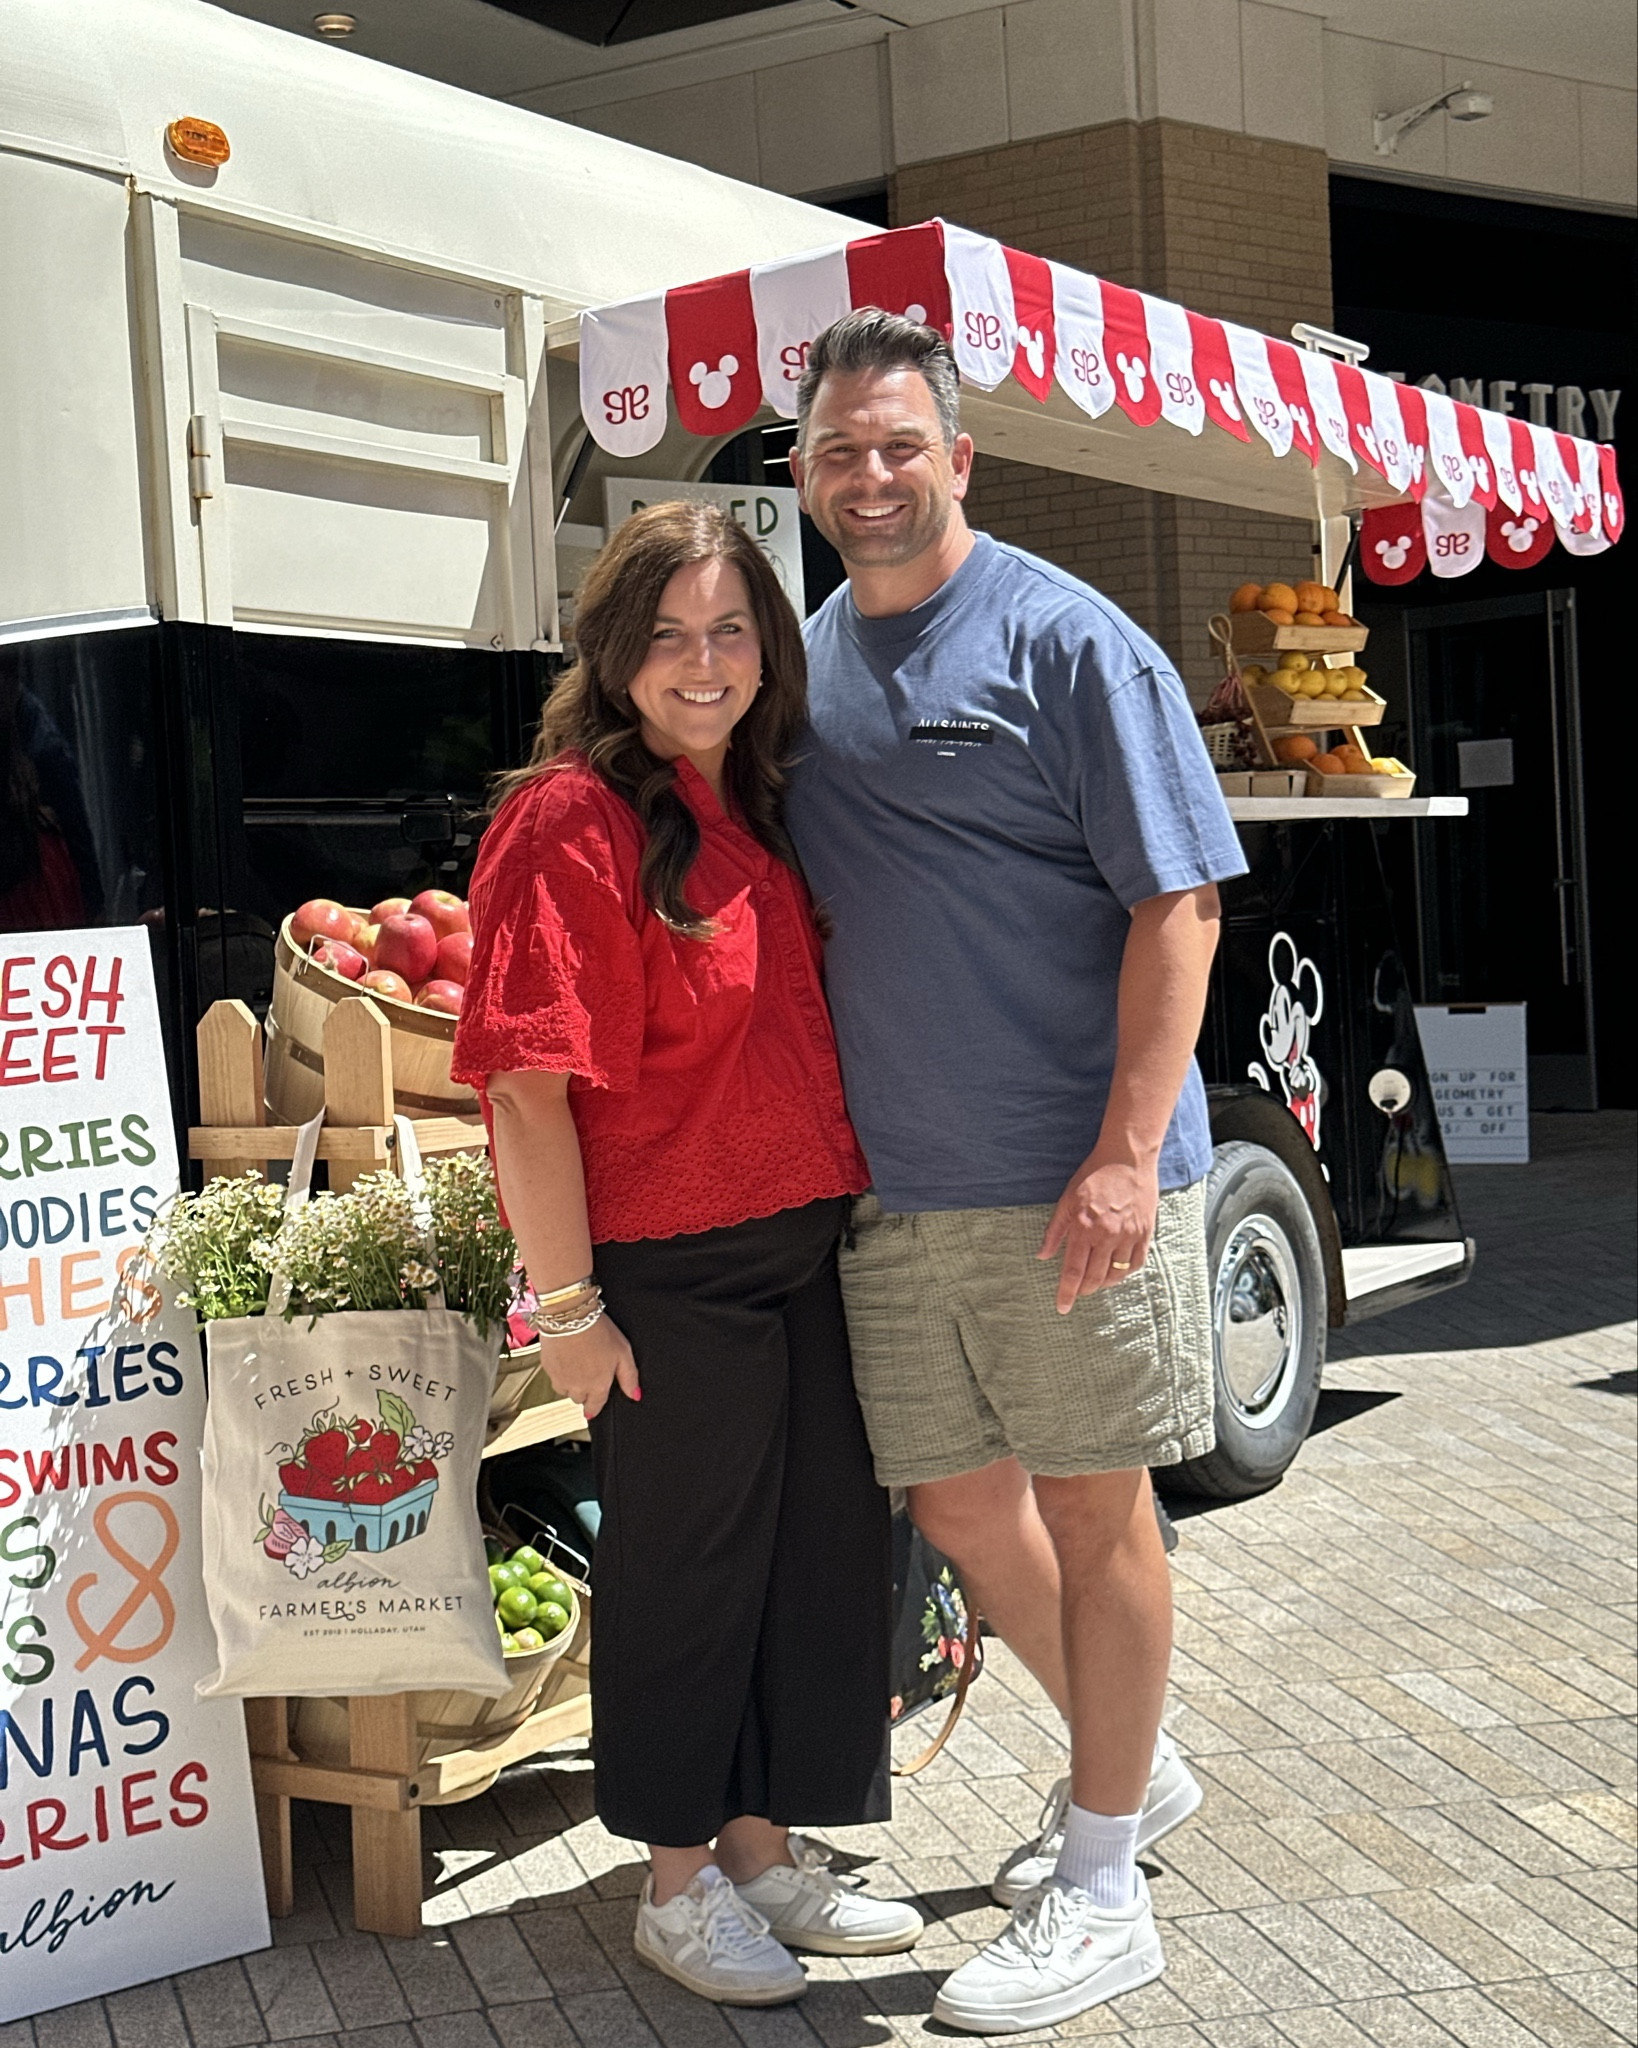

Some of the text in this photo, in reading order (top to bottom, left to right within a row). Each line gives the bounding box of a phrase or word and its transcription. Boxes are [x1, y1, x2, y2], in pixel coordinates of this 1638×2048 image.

[1385, 371, 1621, 441] METRY
[0, 955, 125, 1023] ESH
[0, 1026, 126, 1087] EET
[1459, 1072, 1477, 1082] UP
[1490, 1071, 1516, 1082] FOR
[1435, 1088, 1505, 1101] GEOMETRY
[1465, 1106, 1474, 1118] &
[1486, 1105, 1514, 1118] GET
[1480, 1122, 1507, 1134] OFF
[254, 1368, 333, 1410] FRESH
[368, 1364, 457, 1402] SWEET
[317, 1571, 400, 1593] albion
[259, 1596, 463, 1621] FARMER'S MARKET
[402, 1625, 426, 1633] UTAH
[0, 1615, 55, 1685] S
[0, 1676, 170, 1790] NAS
